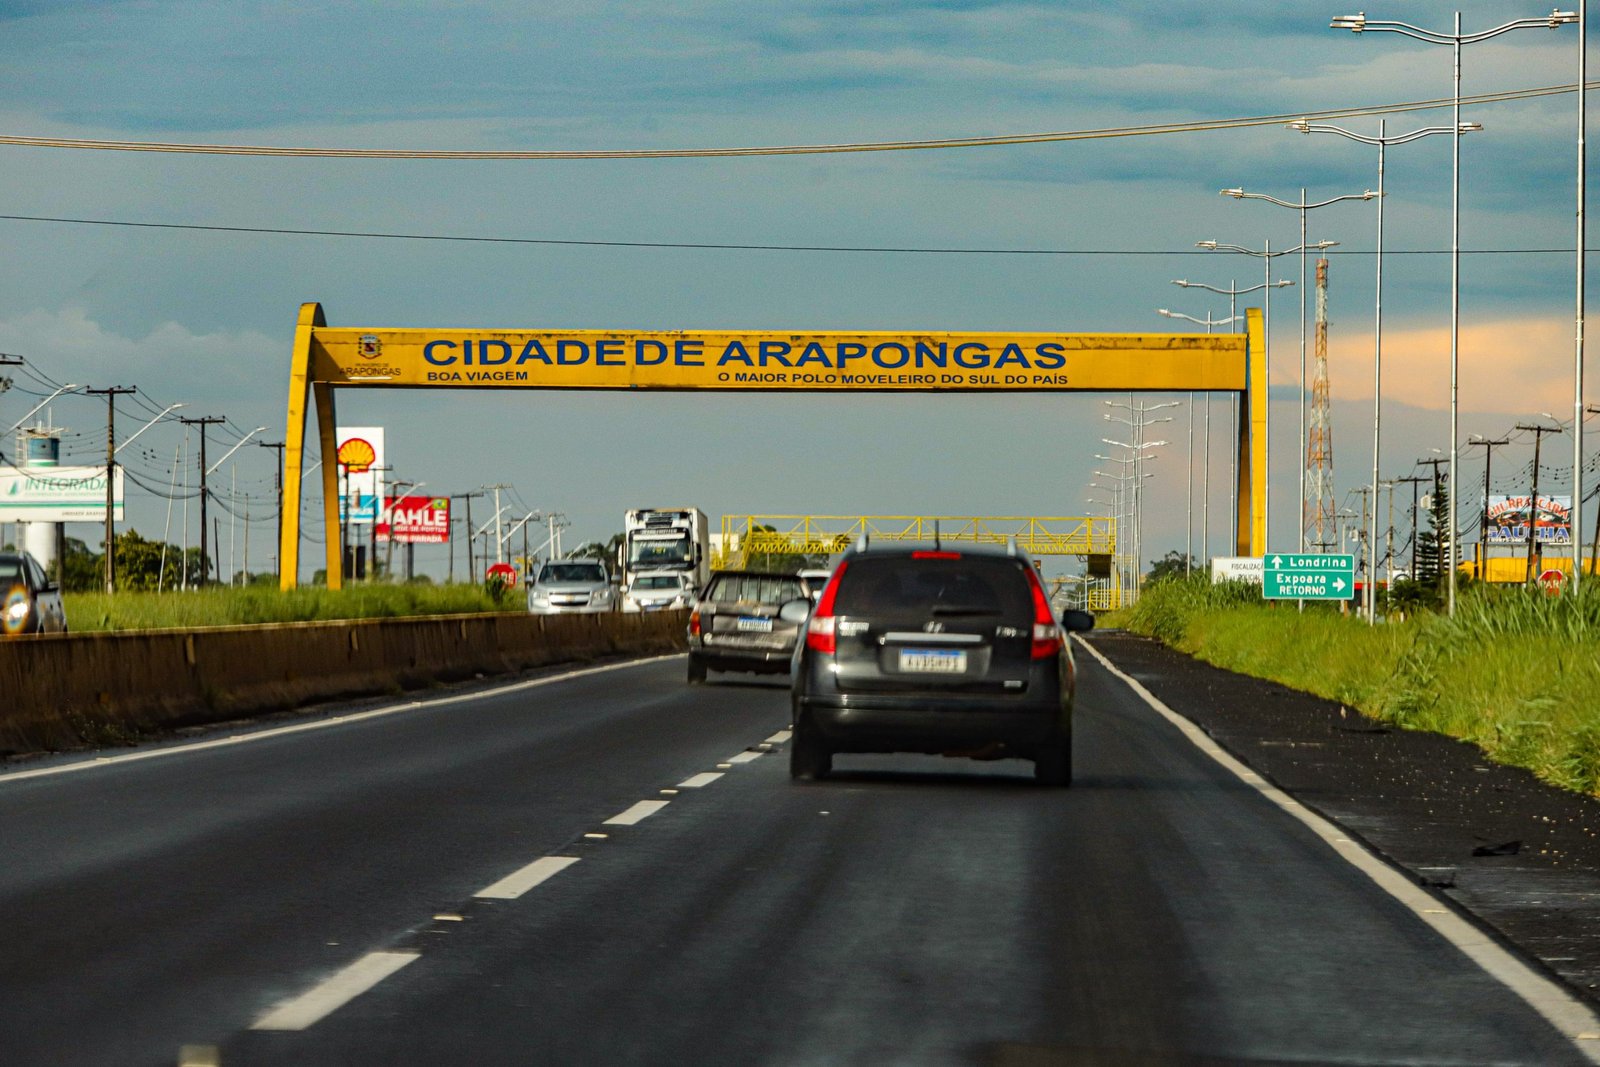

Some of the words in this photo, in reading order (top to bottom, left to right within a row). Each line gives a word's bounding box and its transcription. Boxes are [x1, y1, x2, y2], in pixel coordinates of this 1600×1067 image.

[716, 340, 1066, 370] ARAPONGAS
[339, 367, 401, 376] ARAPONGAS
[427, 371, 462, 381] BOA
[466, 371, 528, 381] VIAGEM
[718, 372, 730, 382] O
[735, 373, 787, 382] MAIOR
[792, 373, 837, 383] POLO
[841, 374, 936, 384] MOVELEIRO
[941, 374, 963, 384] DO
[968, 374, 1000, 384] SUL
[1005, 374, 1027, 384] DO
[1033, 372, 1068, 385] PAÍS
[24, 478, 108, 491] INTEGRADA
[1487, 496, 1569, 520] CHURRACARIA
[1289, 557, 1347, 567] Londrina
[1276, 573, 1327, 586] Expoara
[1279, 585, 1326, 595] RETORNO
